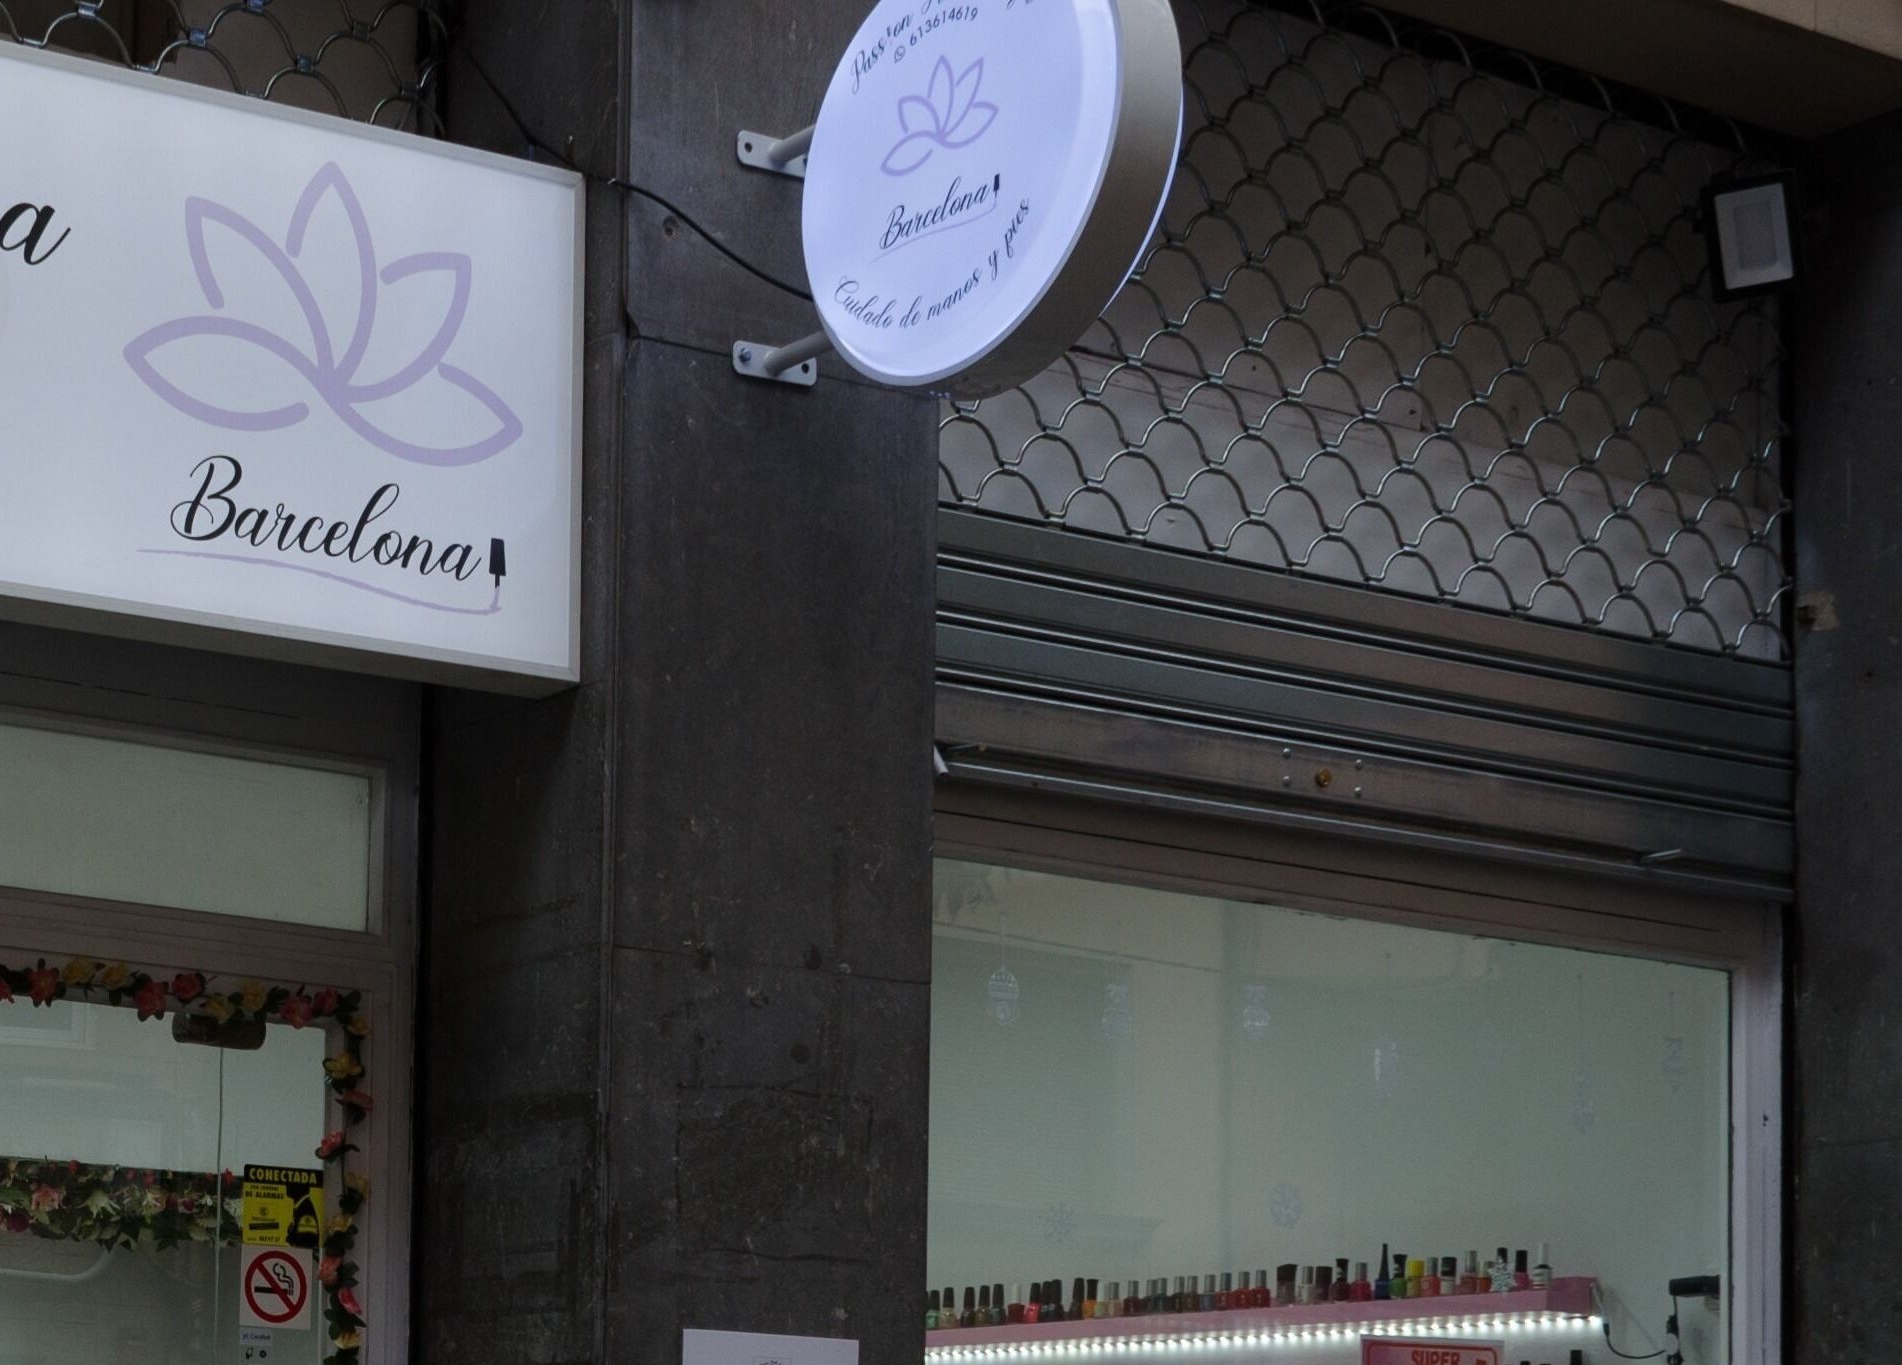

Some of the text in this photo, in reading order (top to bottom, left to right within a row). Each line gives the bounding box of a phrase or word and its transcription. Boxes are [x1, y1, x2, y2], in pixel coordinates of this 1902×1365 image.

[909, 6, 979, 47] 613614619
[879, 175, 989, 250] Barcelona
[834, 275, 894, 330] Cuidado
[899, 300, 923, 329] de
[926, 269, 982, 323] manos
[169, 454, 482, 583] Barcelona
[249, 1167, 318, 1185] CONECTADA
